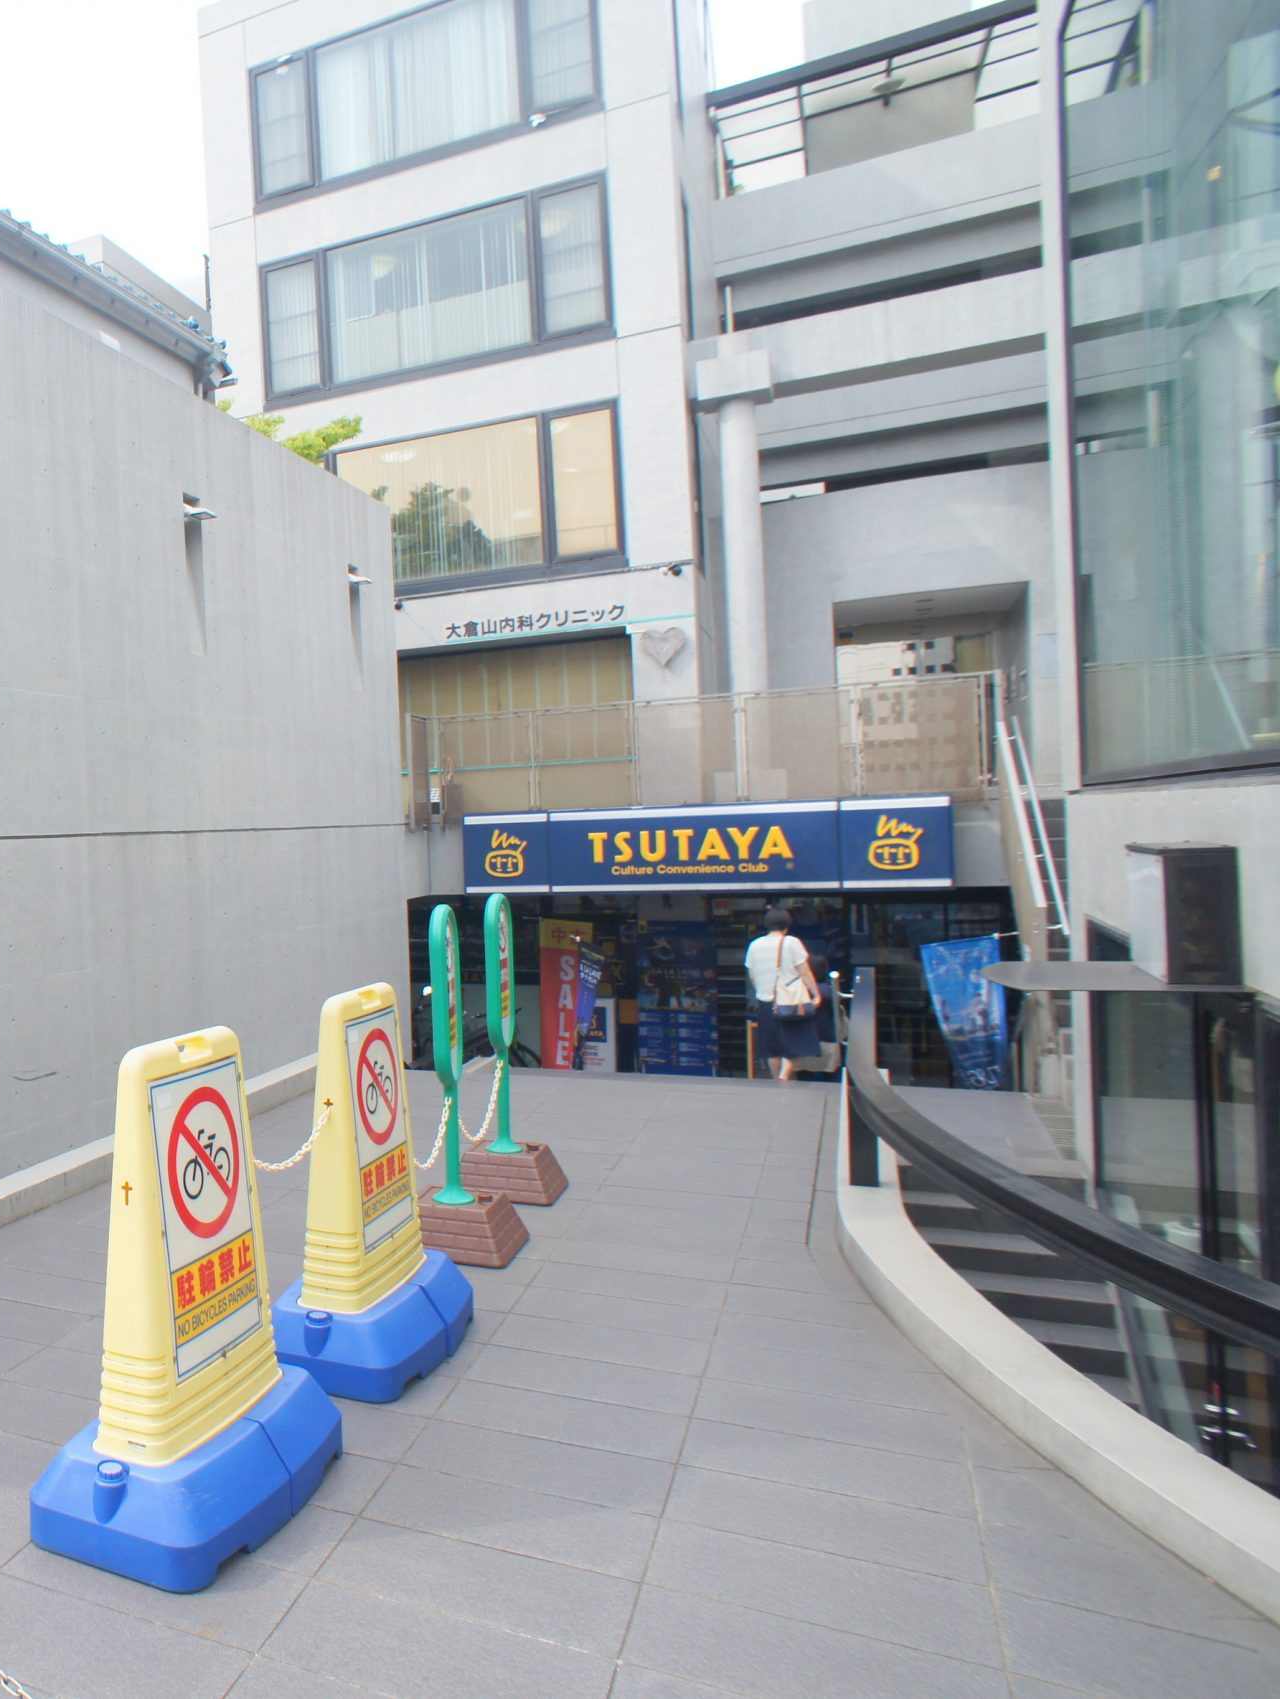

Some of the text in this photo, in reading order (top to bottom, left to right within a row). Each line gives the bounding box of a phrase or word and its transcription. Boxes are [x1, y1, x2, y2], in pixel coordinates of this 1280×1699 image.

[445, 604, 625, 640] 大倉山内科クリニック
[587, 826, 794, 863] TSUTAYA
[611, 862, 768, 876] Culture Convenience Club
[555, 954, 575, 1066] SALE
[176, 1238, 253, 1310] 駐輪禁止
[177, 1277, 256, 1339] NO BICYCLES PARKING
